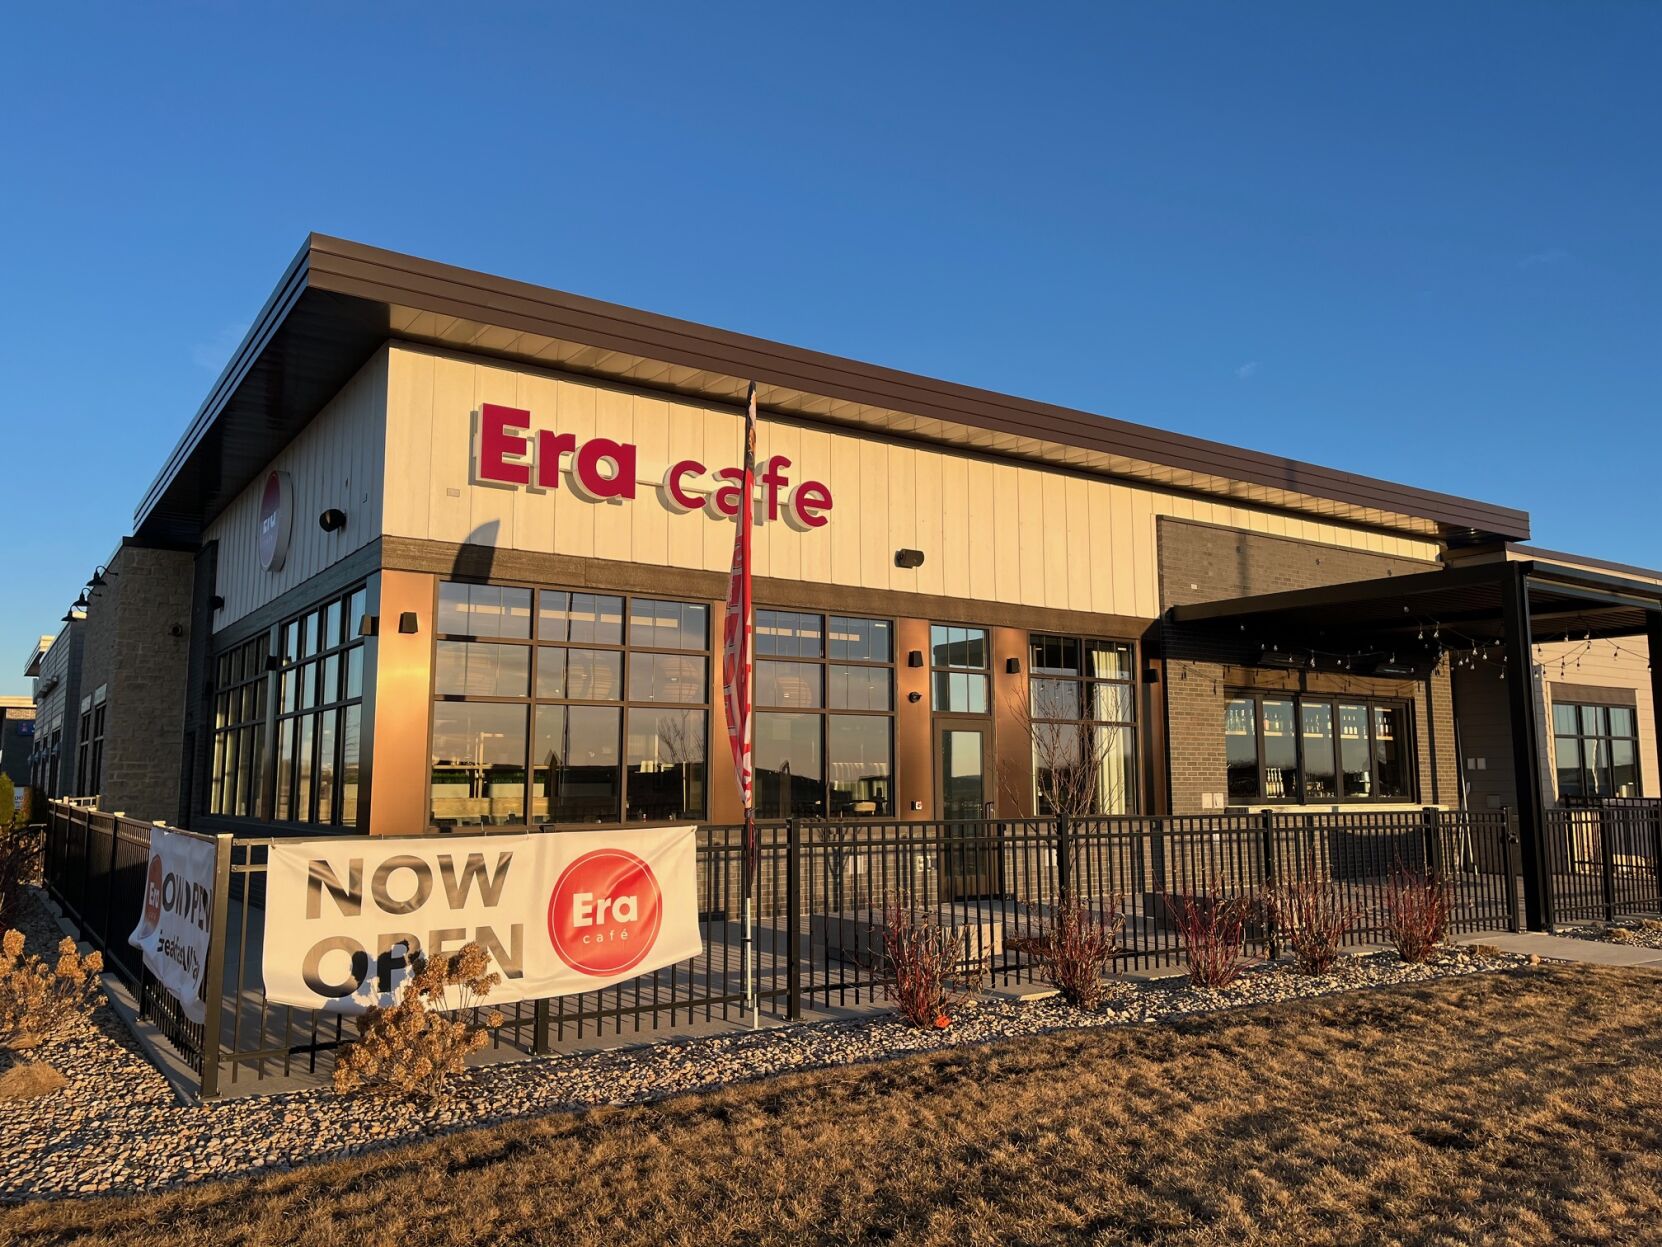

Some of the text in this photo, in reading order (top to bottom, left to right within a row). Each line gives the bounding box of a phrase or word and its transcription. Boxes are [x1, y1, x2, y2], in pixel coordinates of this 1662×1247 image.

[479, 402, 834, 528] Era cafe
[306, 851, 514, 920] NOW
[572, 892, 638, 928] Era
[582, 927, 629, 944] café
